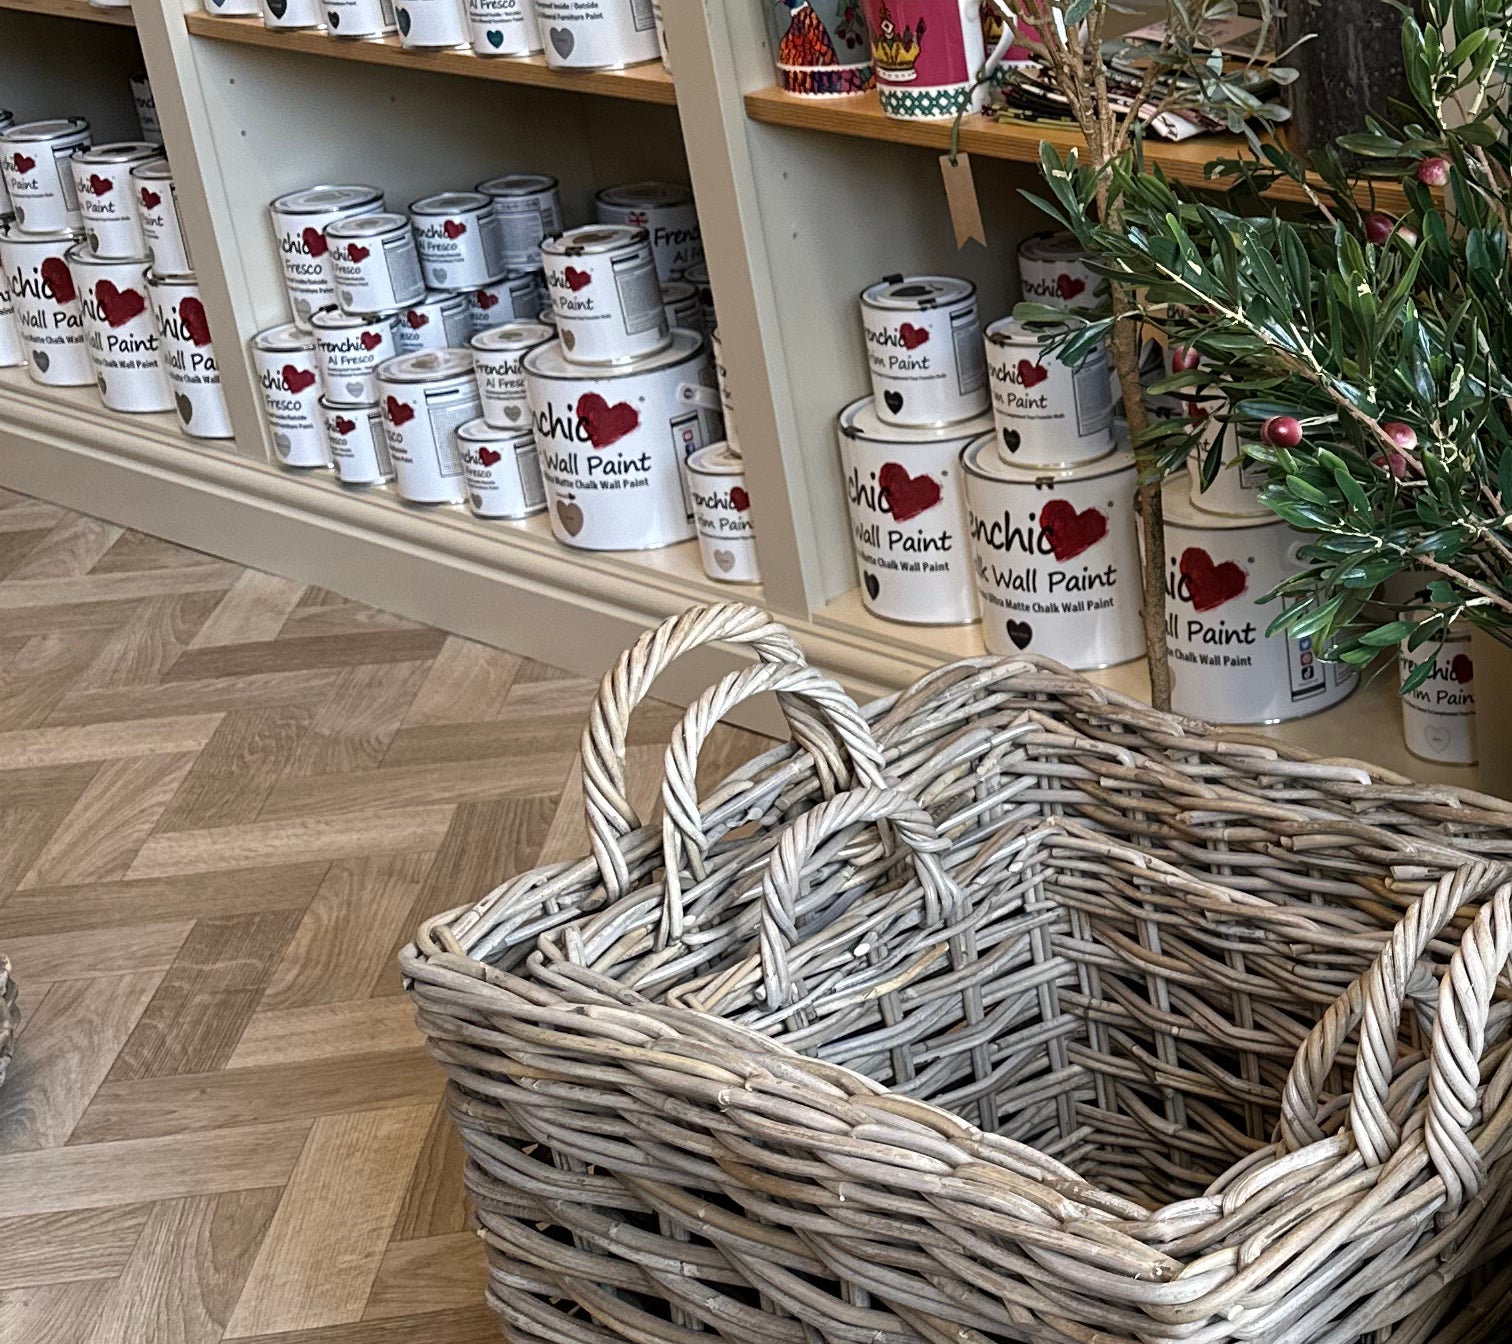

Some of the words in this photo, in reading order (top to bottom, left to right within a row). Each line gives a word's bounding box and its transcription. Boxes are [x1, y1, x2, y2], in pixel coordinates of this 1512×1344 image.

[11, 177, 39, 190] Paint
[86, 201, 115, 214] Paint
[282, 233, 312, 256] chic
[286, 260, 322, 276] Fresco
[11, 266, 55, 300] chic
[549, 271, 571, 289] chic
[559, 296, 594, 311] Paint
[20, 310, 47, 329] Wall
[54, 312, 83, 329] Pai
[107, 333, 159, 353] Paint
[864, 324, 906, 348] enchic
[328, 357, 338, 366] Al
[341, 355, 375, 365] Fresco
[889, 355, 930, 371] Paint
[261, 369, 288, 391] chic
[990, 361, 1023, 386] nchic
[499, 377, 524, 388] Fresc
[266, 395, 302, 412] Fresco
[1007, 393, 1048, 410] Paint
[546, 452, 579, 476] Wall
[587, 453, 651, 476] Paint
[575, 479, 598, 490] Chalk
[600, 479, 621, 490] Wall
[623, 477, 649, 488] Paint
[849, 467, 892, 514] chic
[719, 517, 754, 532] Pain
[888, 529, 953, 553] Paint
[900, 559, 921, 572] Wall
[922, 561, 950, 572] Paint
[992, 564, 1037, 593] Wall
[1048, 565, 1117, 593] Paint
[1005, 598, 1030, 613] Matte
[1032, 601, 1060, 614] Chalk
[1061, 601, 1085, 614] Wall
[1087, 597, 1115, 611] Paint
[1187, 620, 1257, 646] Paint
[1174, 648, 1198, 664] Chalk
[1199, 654, 1221, 666] Wall
[1223, 656, 1252, 667] Paint
[1436, 689, 1475, 706] Pain
